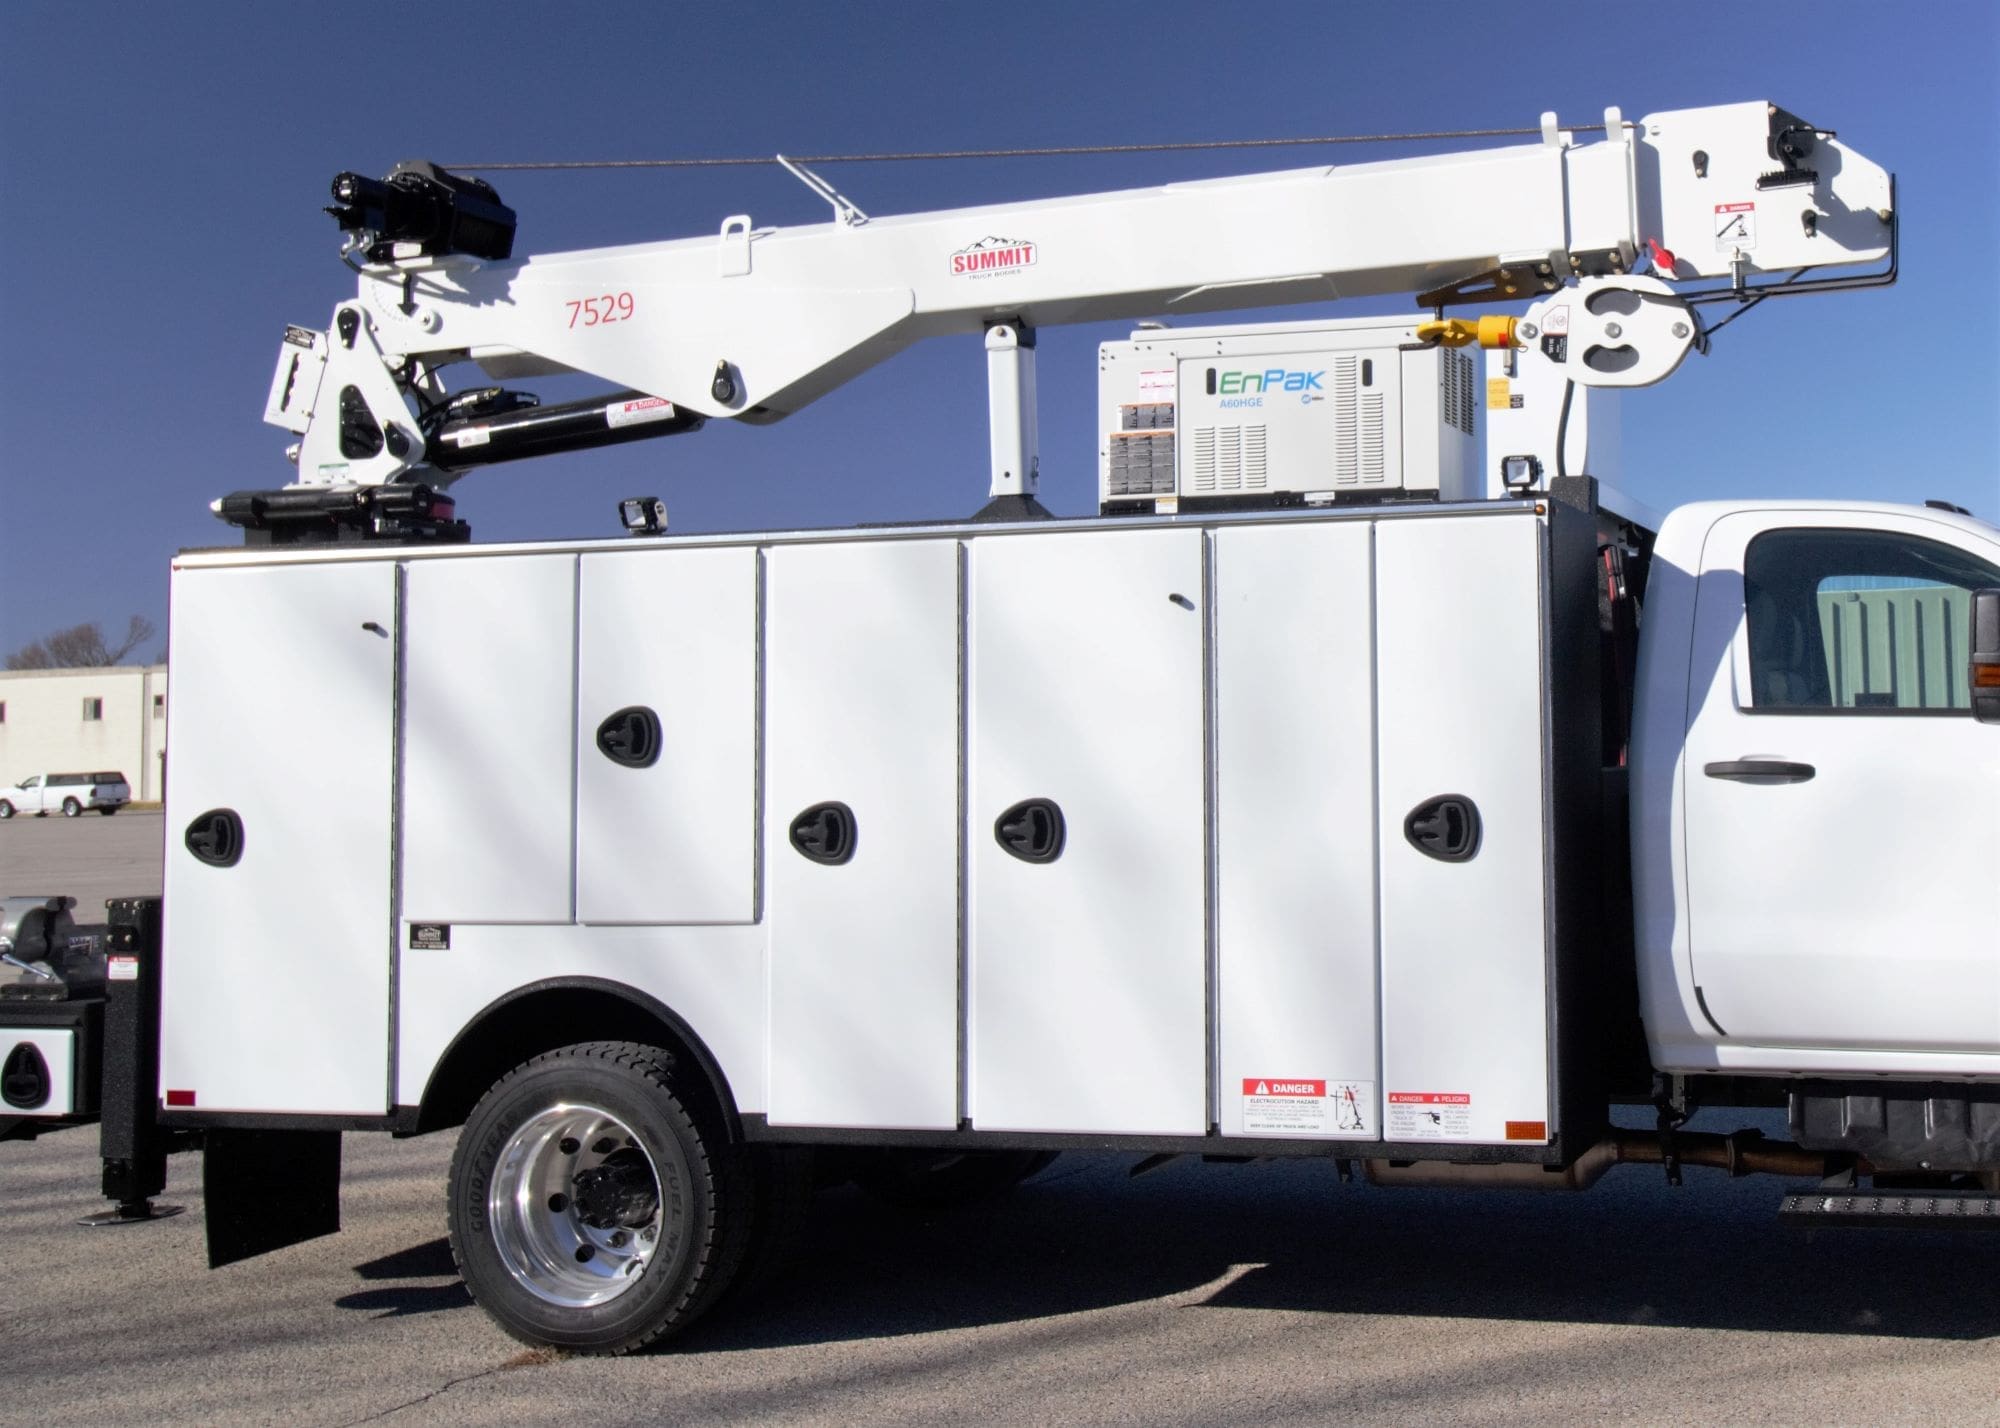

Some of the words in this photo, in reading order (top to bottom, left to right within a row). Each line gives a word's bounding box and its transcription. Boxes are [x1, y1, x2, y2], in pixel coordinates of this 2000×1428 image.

[954, 246, 1033, 273] SUMMIT
[969, 272, 993, 281] TRUCK
[566, 292, 634, 329] 7529
[1219, 369, 1326, 395] EnPak
[1219, 397, 1264, 409] A60HGE
[1272, 1083, 1316, 1094] DANGER
[1398, 1095, 1424, 1103] DANGER
[1441, 1095, 1468, 1103] PELIGRO
[664, 1161, 682, 1216] FUEL
